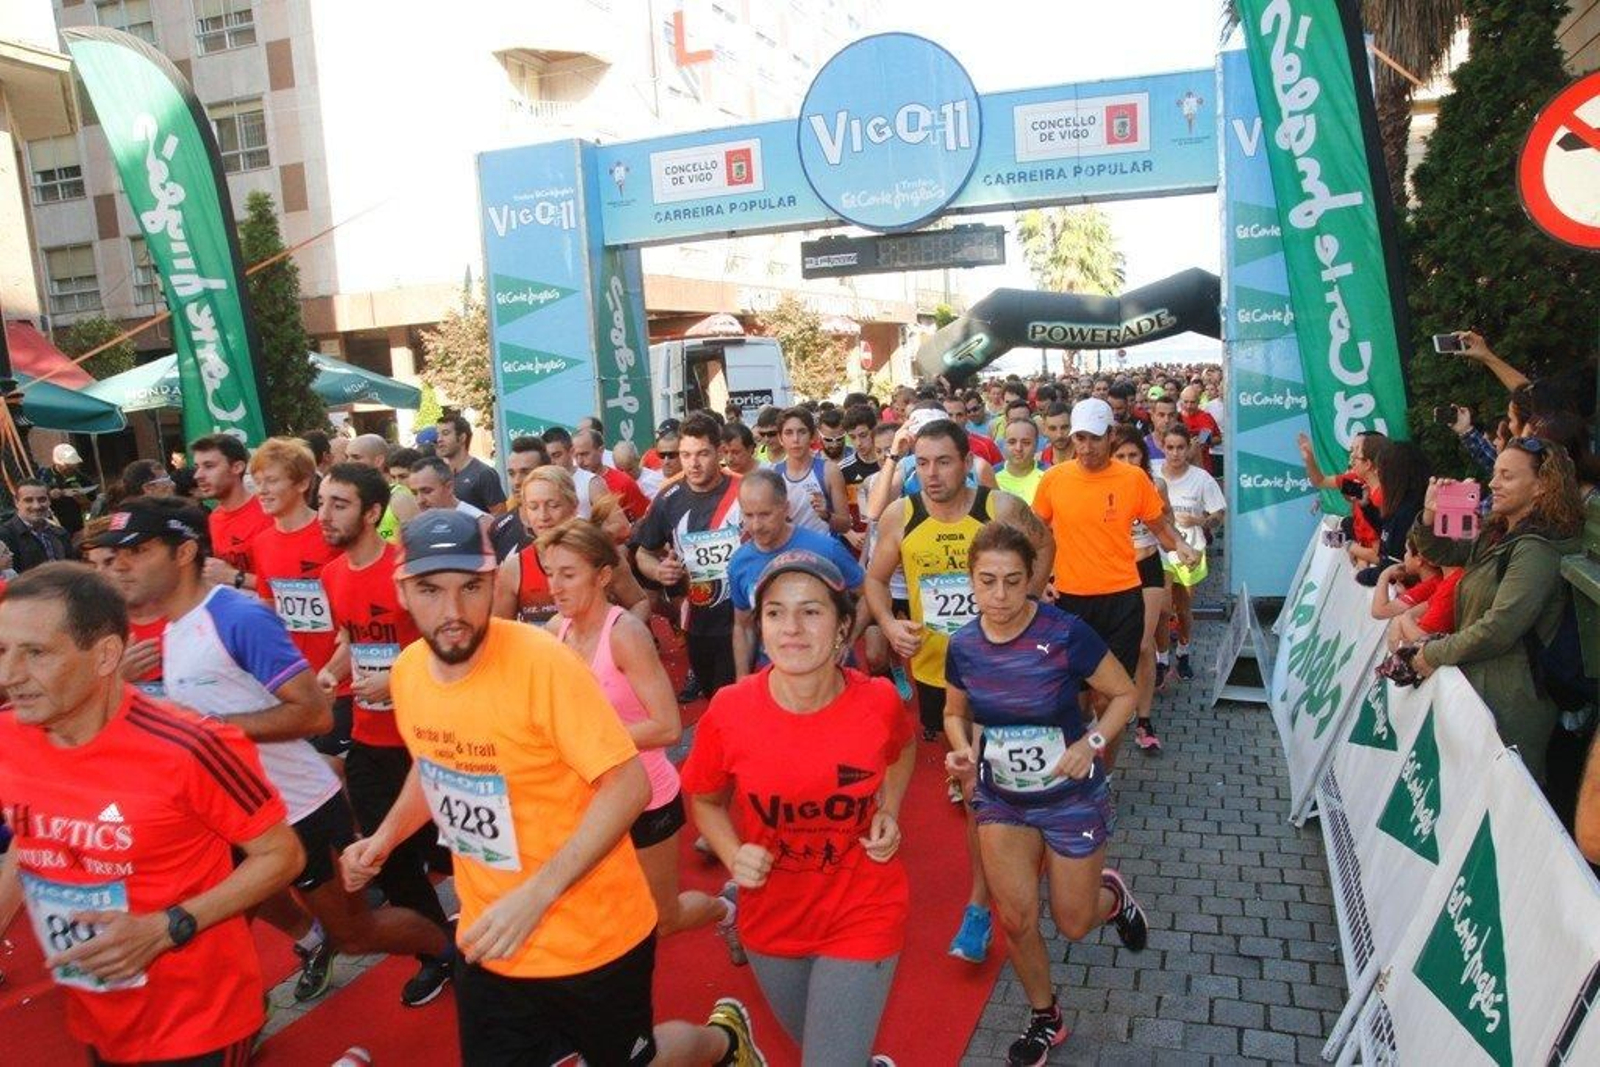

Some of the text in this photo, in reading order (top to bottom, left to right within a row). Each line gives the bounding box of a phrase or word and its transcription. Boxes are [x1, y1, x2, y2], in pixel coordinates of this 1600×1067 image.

[1031, 115, 1096, 131] CONCELLO
[1039, 127, 1089, 143] DE VIGO
[665, 160, 718, 176] CONCELLO
[983, 160, 1153, 186] CARREIRA POPULAR
[671, 172, 713, 186] DE VIGO
[841, 181, 946, 208] El Corte Inglés
[654, 195, 797, 223] CARREIRA POPULAR
[1235, 224, 1282, 239] El Corte
[506, 291, 527, 304] Corte
[1237, 308, 1250, 323] El
[1250, 307, 1282, 322] Corte
[1030, 311, 1171, 344] POWERADE
[606, 276, 640, 413] Inglés
[512, 360, 534, 373] Corte
[1238, 391, 1253, 406] El
[1252, 391, 1283, 406] Corte
[1239, 473, 1254, 488] El
[1252, 474, 1284, 488] Corte
[695, 544, 734, 567] 852
[278, 597, 324, 617] 1076
[1007, 746, 1047, 773] 53
[439, 795, 500, 840] 428
[1460, 926, 1504, 1033] Inglés
